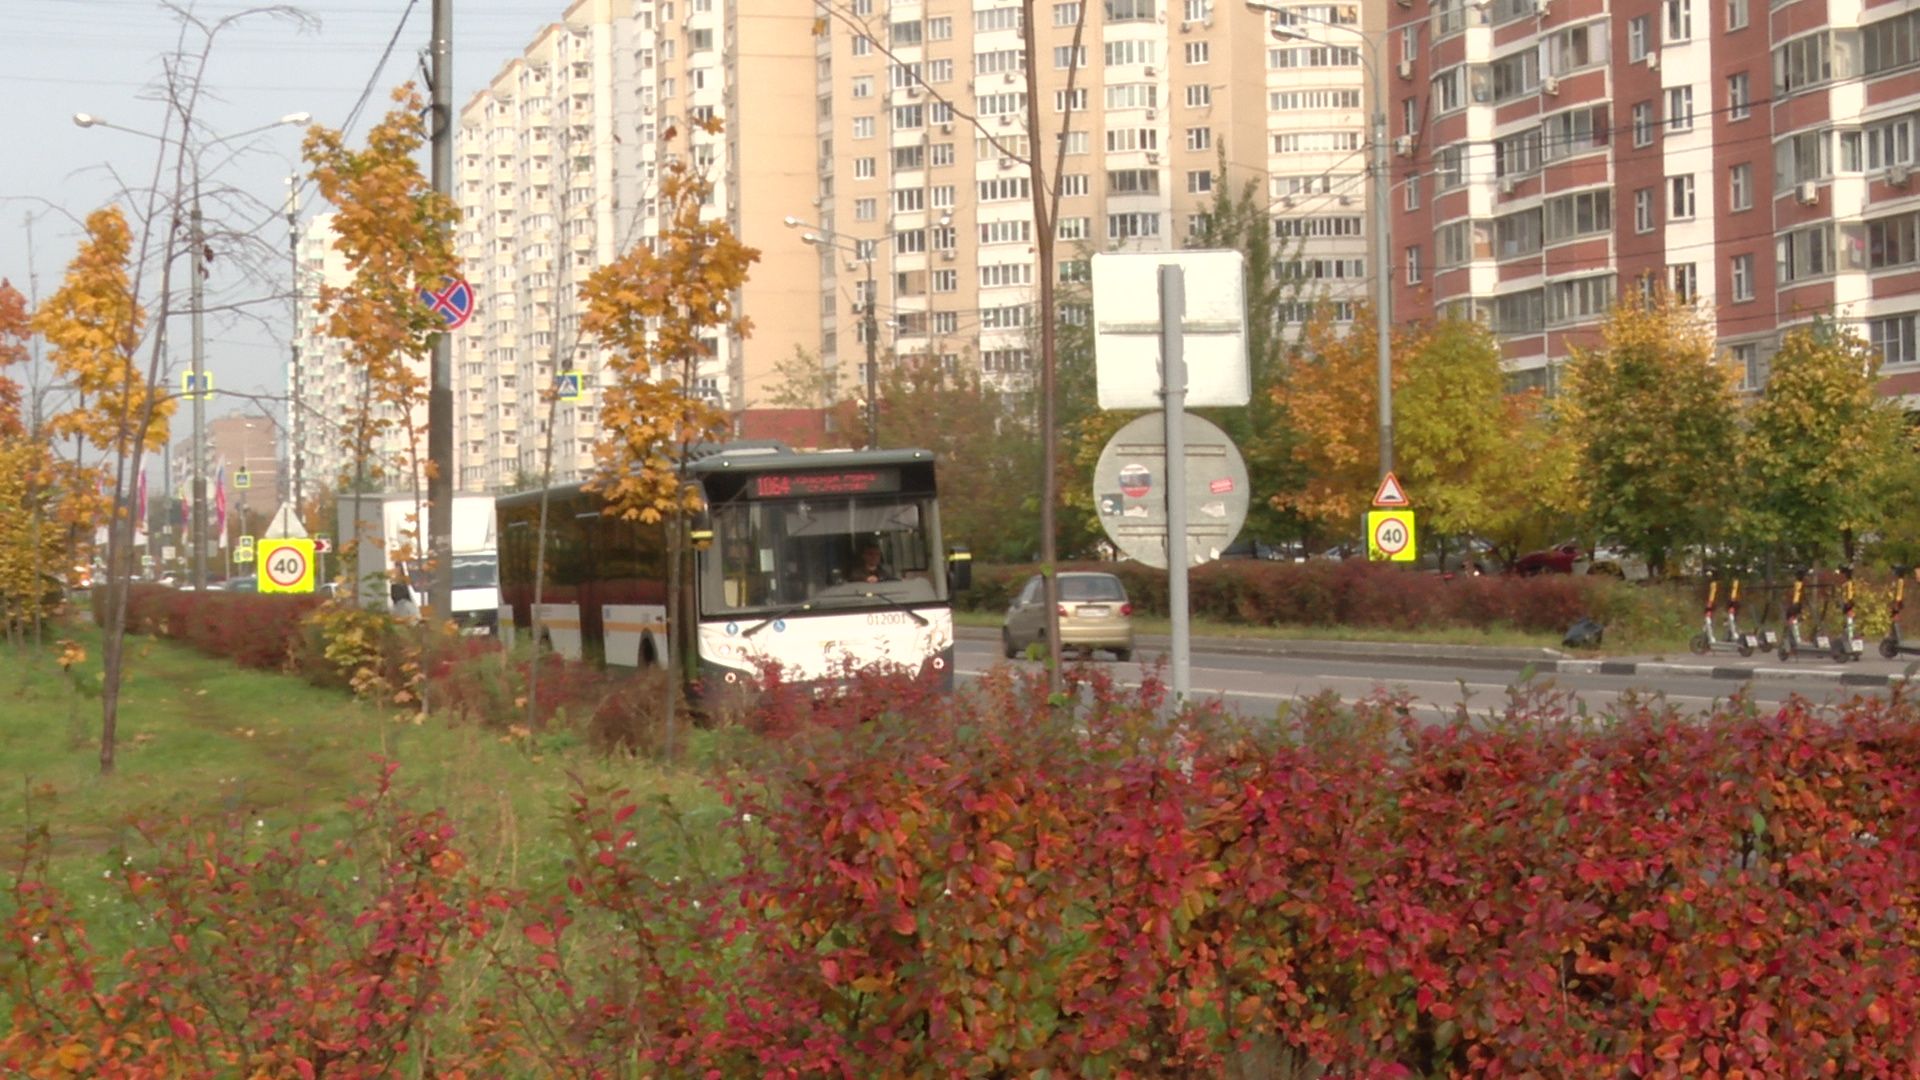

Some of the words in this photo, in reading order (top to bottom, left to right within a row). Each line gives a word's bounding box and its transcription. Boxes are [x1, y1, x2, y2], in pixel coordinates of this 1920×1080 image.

[1382, 528, 1402, 544] 40
[274, 558, 298, 574] 40
[867, 614, 906, 626] 012001
